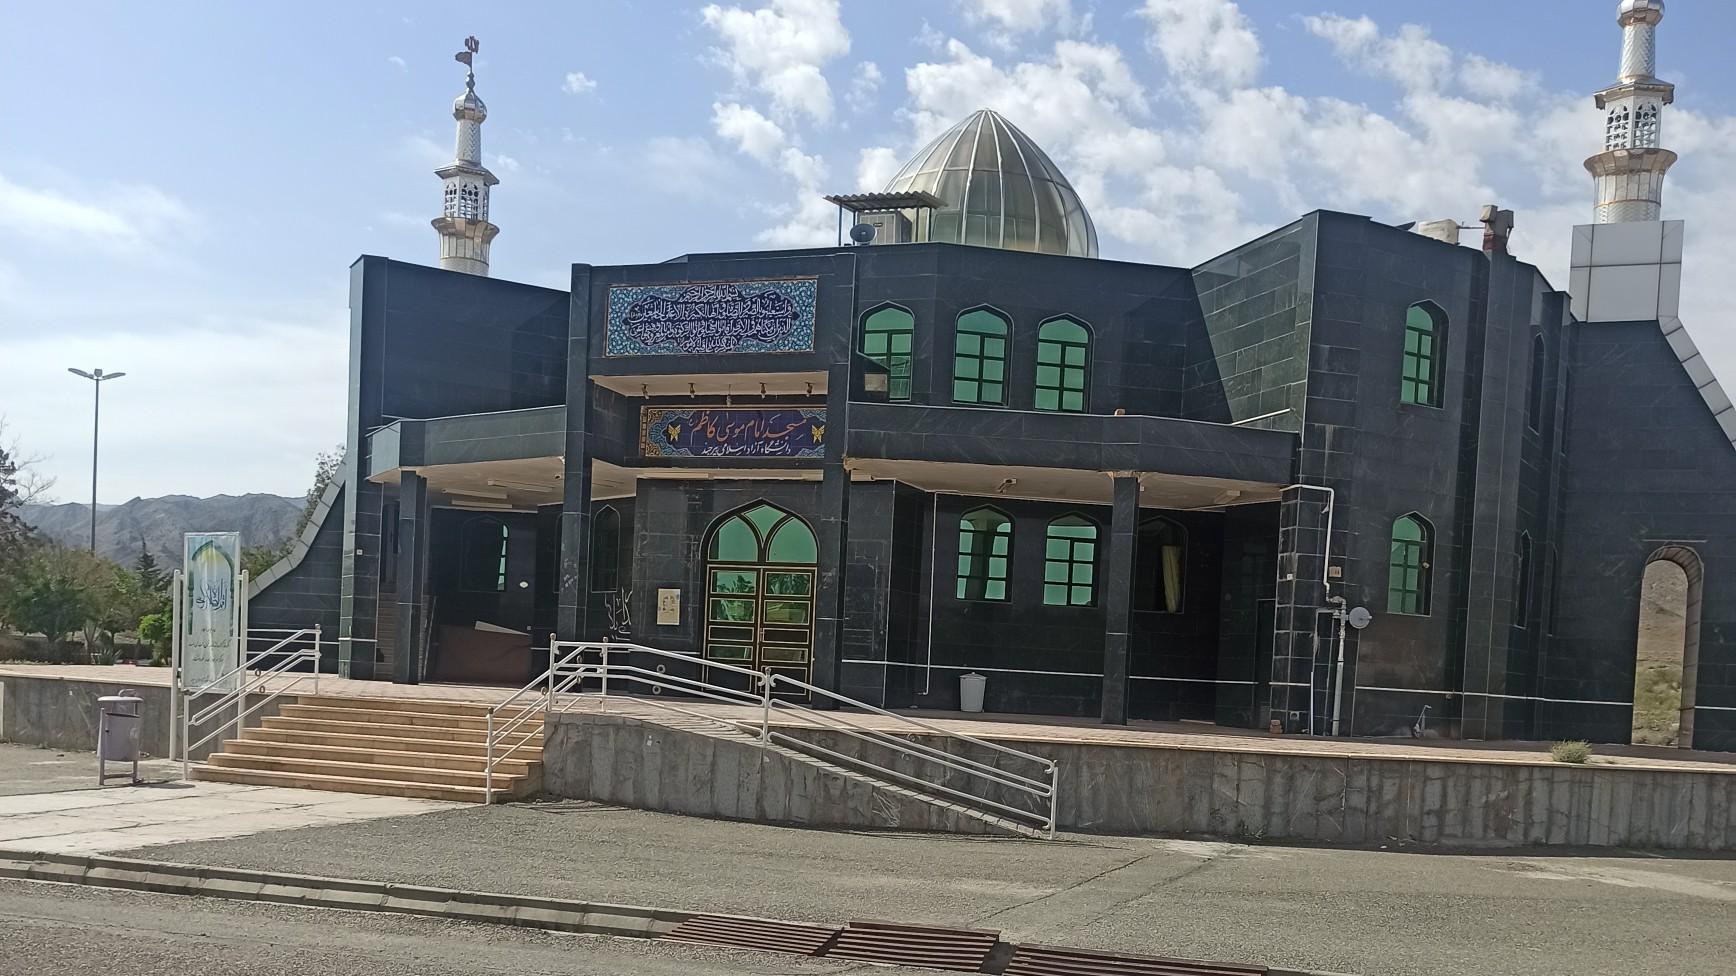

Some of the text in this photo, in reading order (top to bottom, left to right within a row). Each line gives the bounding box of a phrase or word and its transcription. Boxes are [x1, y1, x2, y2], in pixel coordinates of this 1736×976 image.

[690, 411, 719, 447] کاظم
[744, 417, 765, 441] امام
[762, 413, 807, 441] مسجد
[701, 439, 791, 456] دانشگاه آزاد اسلامی بیرجند
